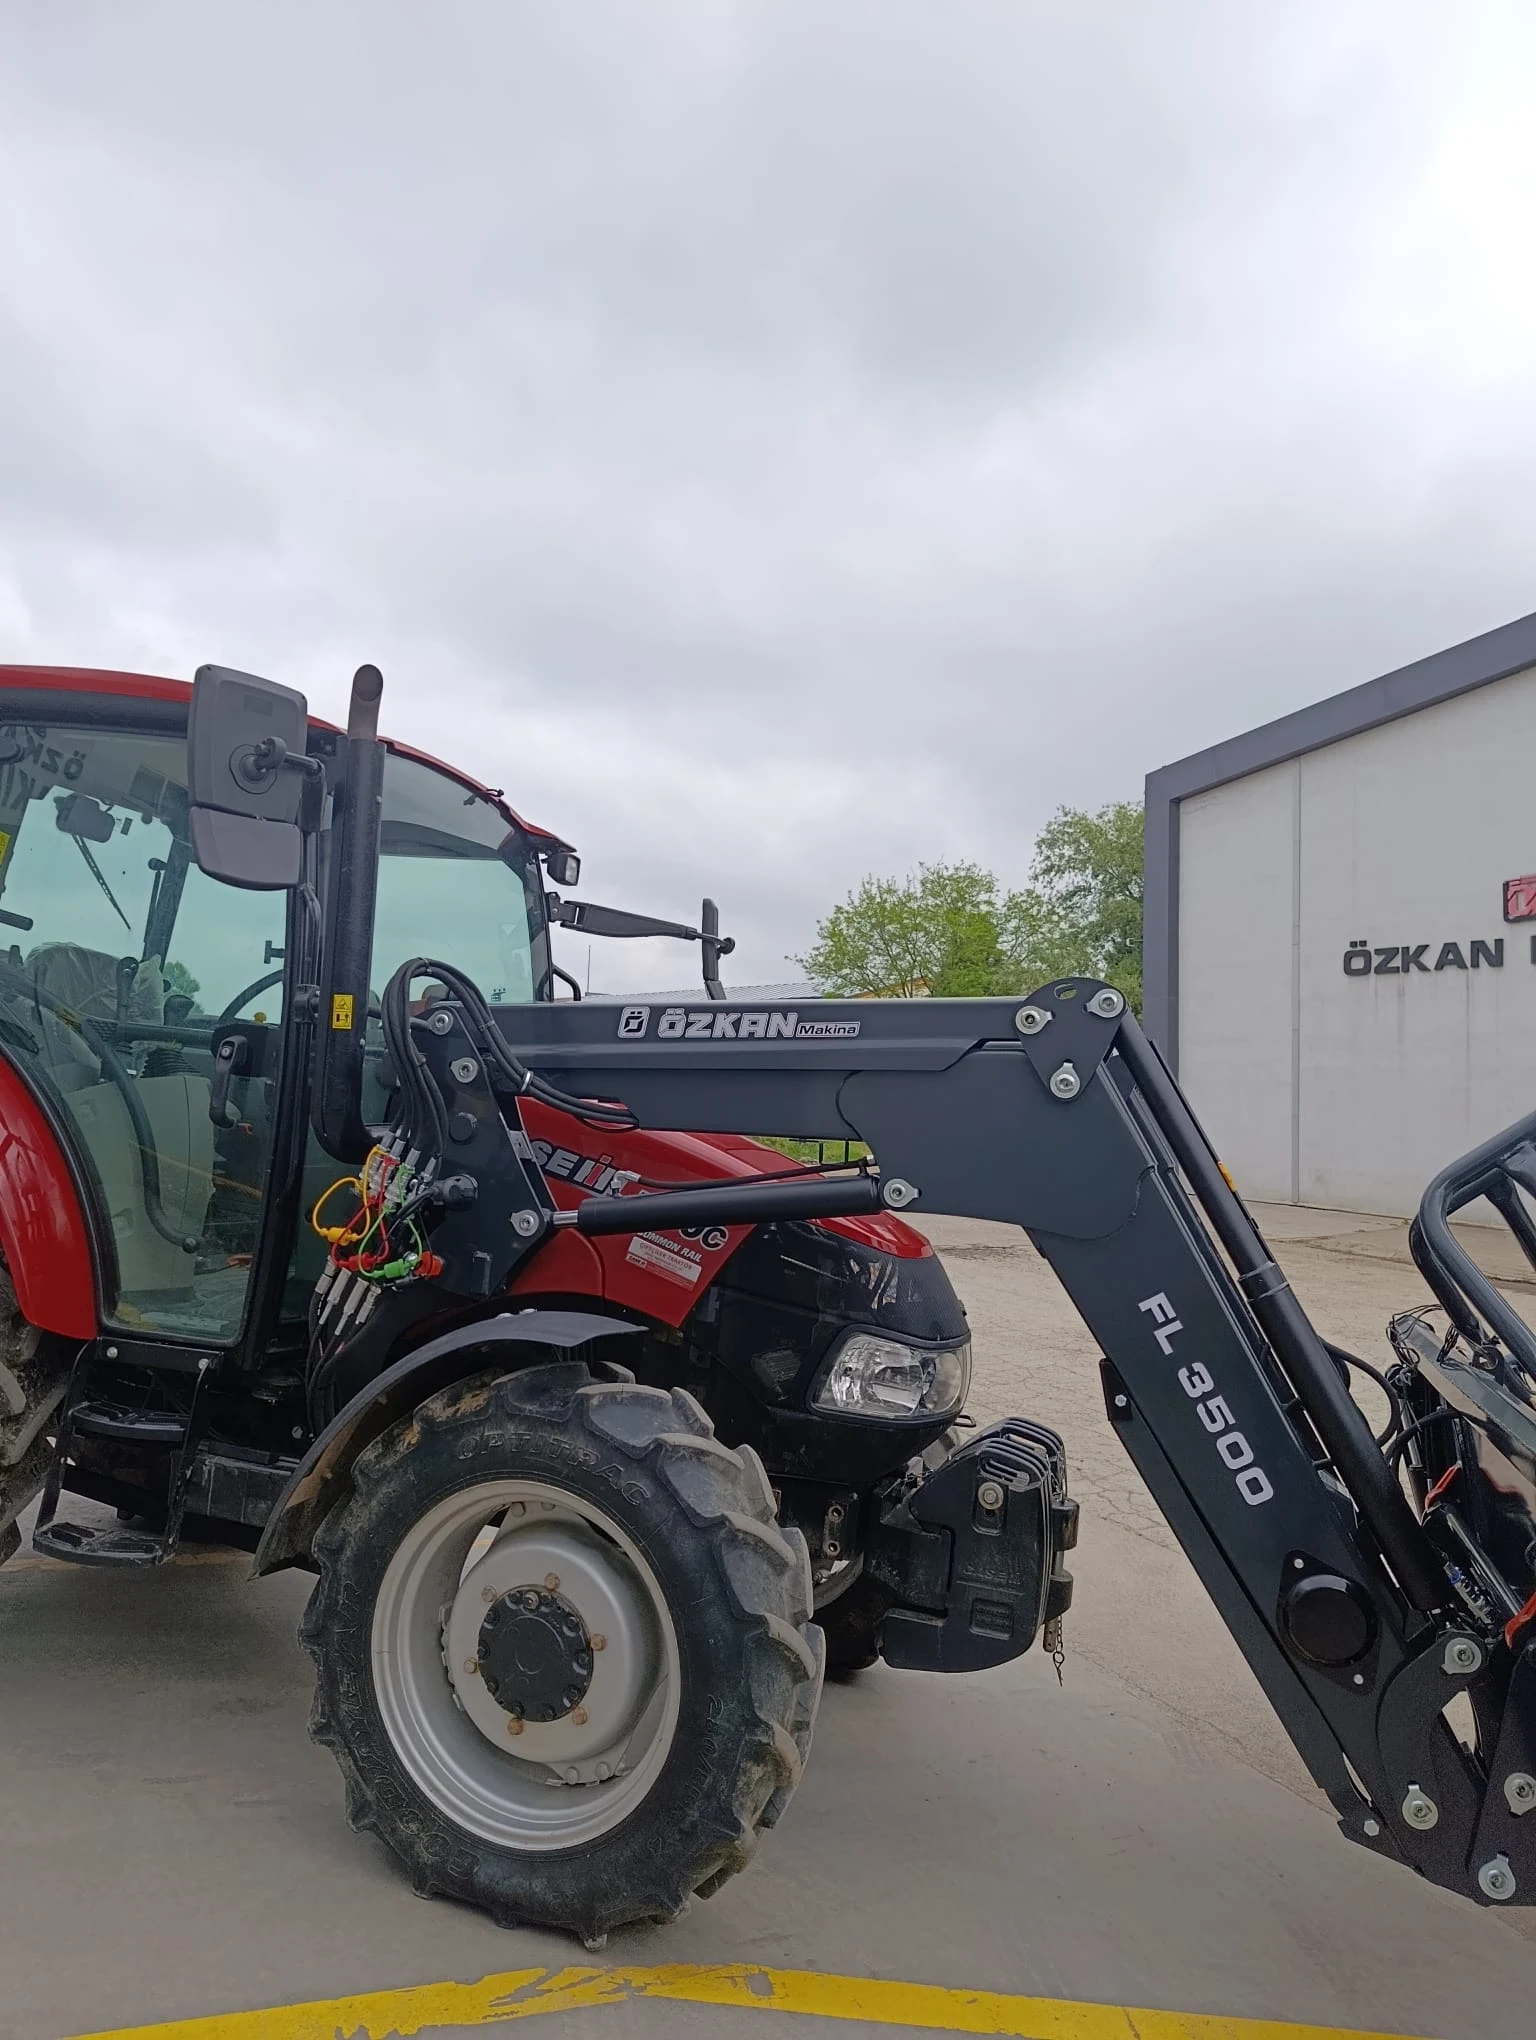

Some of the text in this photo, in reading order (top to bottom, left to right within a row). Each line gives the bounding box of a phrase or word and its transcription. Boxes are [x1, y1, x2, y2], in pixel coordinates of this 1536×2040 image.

[1343, 938, 1505, 976] ÖZKAN
[658, 1008, 798, 1038] ÖZKAN
[799, 1024, 857, 1035] Makina
[680, 1247, 703, 1262] RAIL
[1137, 1291, 1274, 1508] FL 3500
[456, 1430, 651, 1507] OPTITRAC
